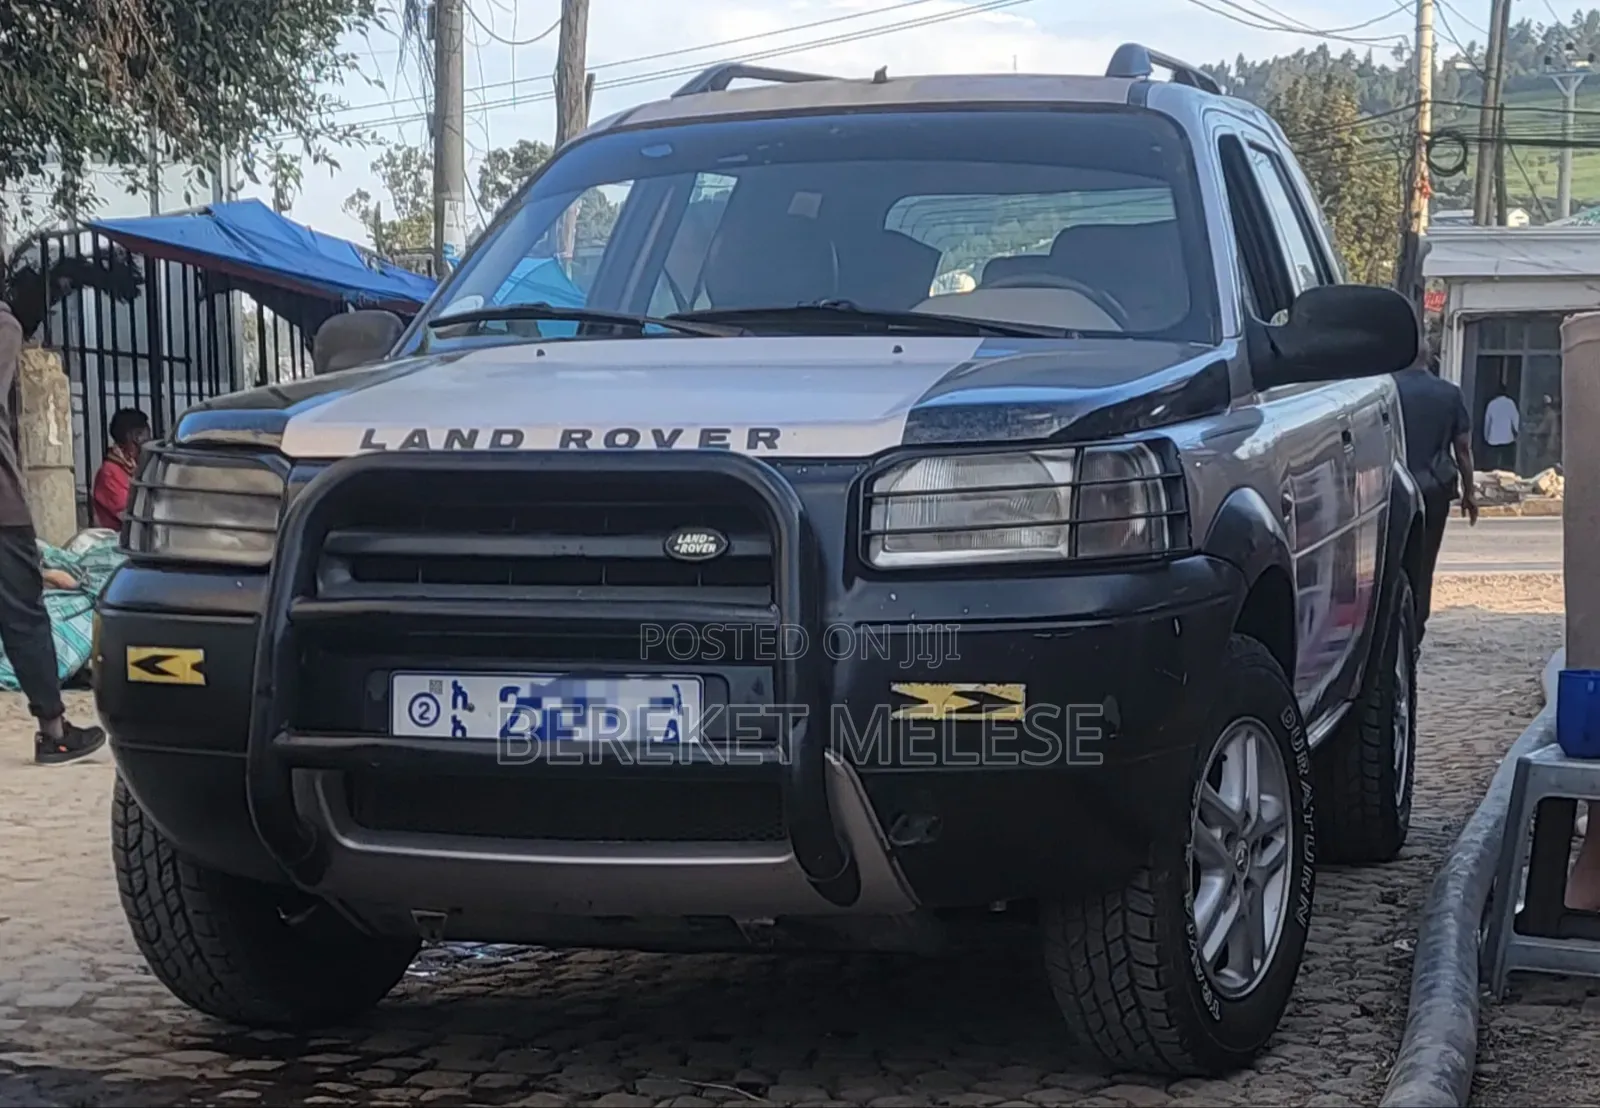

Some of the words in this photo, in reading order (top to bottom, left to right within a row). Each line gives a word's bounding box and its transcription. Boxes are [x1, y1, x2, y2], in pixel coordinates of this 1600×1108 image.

[358, 428, 526, 450] LAND
[558, 427, 782, 450] ROVER
[677, 533, 707, 544] LAND
[679, 543, 717, 554] ROVER
